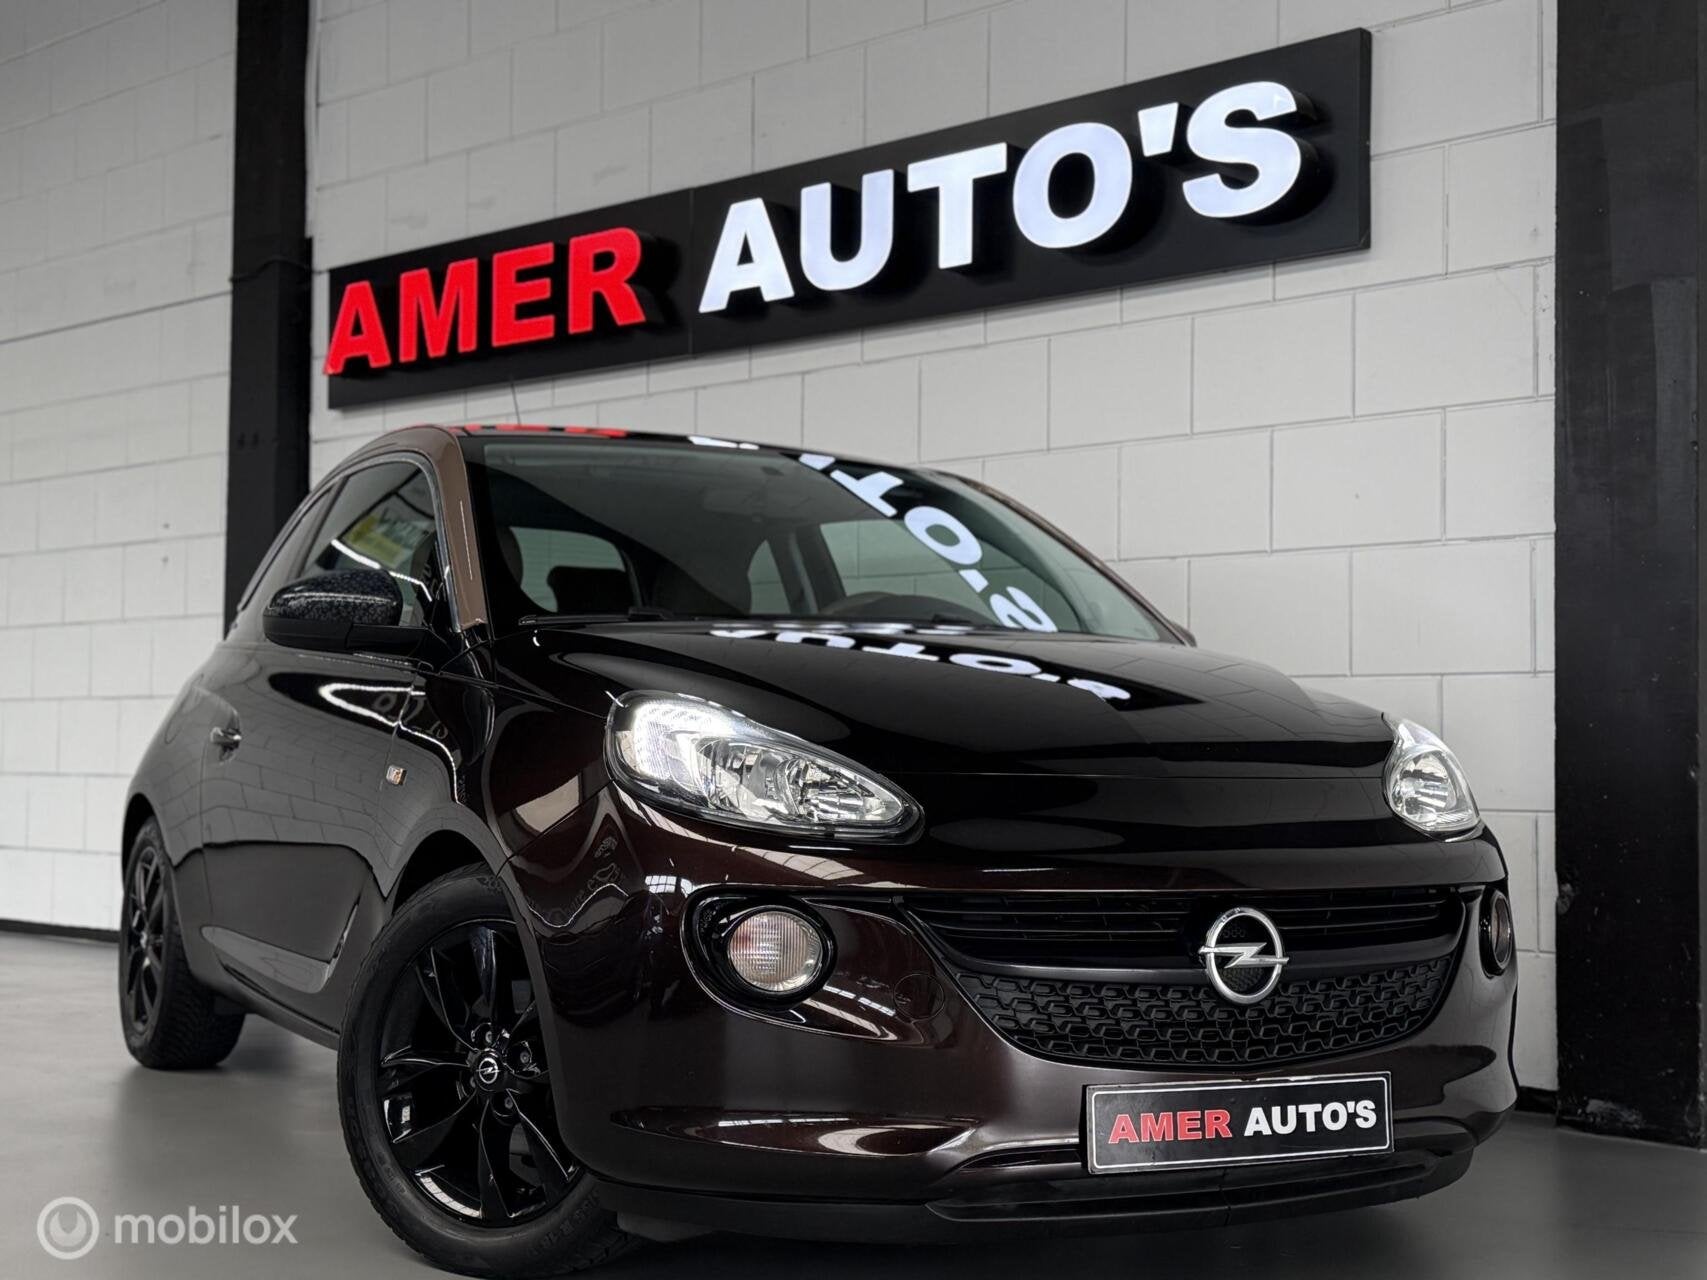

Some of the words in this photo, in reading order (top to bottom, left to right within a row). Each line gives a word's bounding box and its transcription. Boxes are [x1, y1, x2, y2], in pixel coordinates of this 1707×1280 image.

[322, 226, 646, 376] AMER
[698, 81, 1302, 313] AUTO'S
[1108, 1109, 1232, 1144] AMER
[1243, 1099, 1377, 1137] AUTO'S
